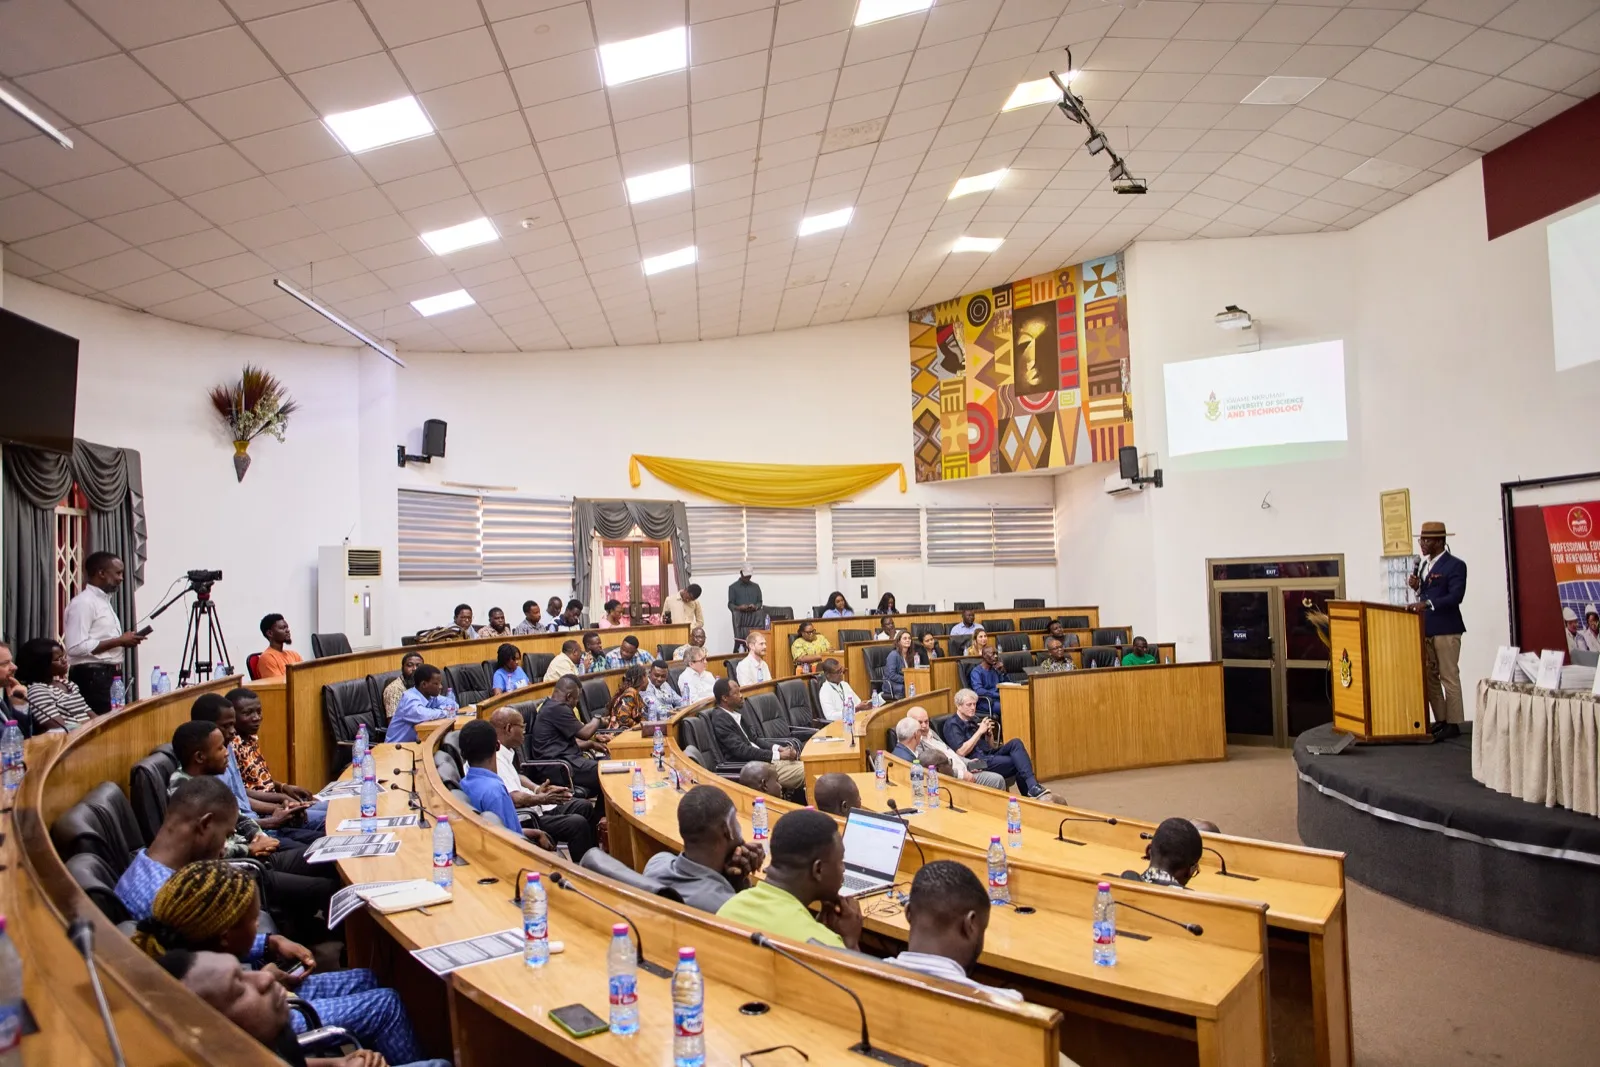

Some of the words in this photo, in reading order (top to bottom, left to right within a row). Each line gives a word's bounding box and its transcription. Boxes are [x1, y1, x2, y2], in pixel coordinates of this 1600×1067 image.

[1227, 401, 1264, 411] UNIVERSITY
[1275, 396, 1304, 406] SCIENCE
[1227, 410, 1245, 419] AND
[1247, 403, 1304, 417] TECHNOLOGY
[1550, 541, 1589, 553] PROFESSIONAL
[1553, 553, 1565, 564] FOR
[1565, 552, 1599, 563] RENEWABLE
[1575, 564, 1582, 574] IN
